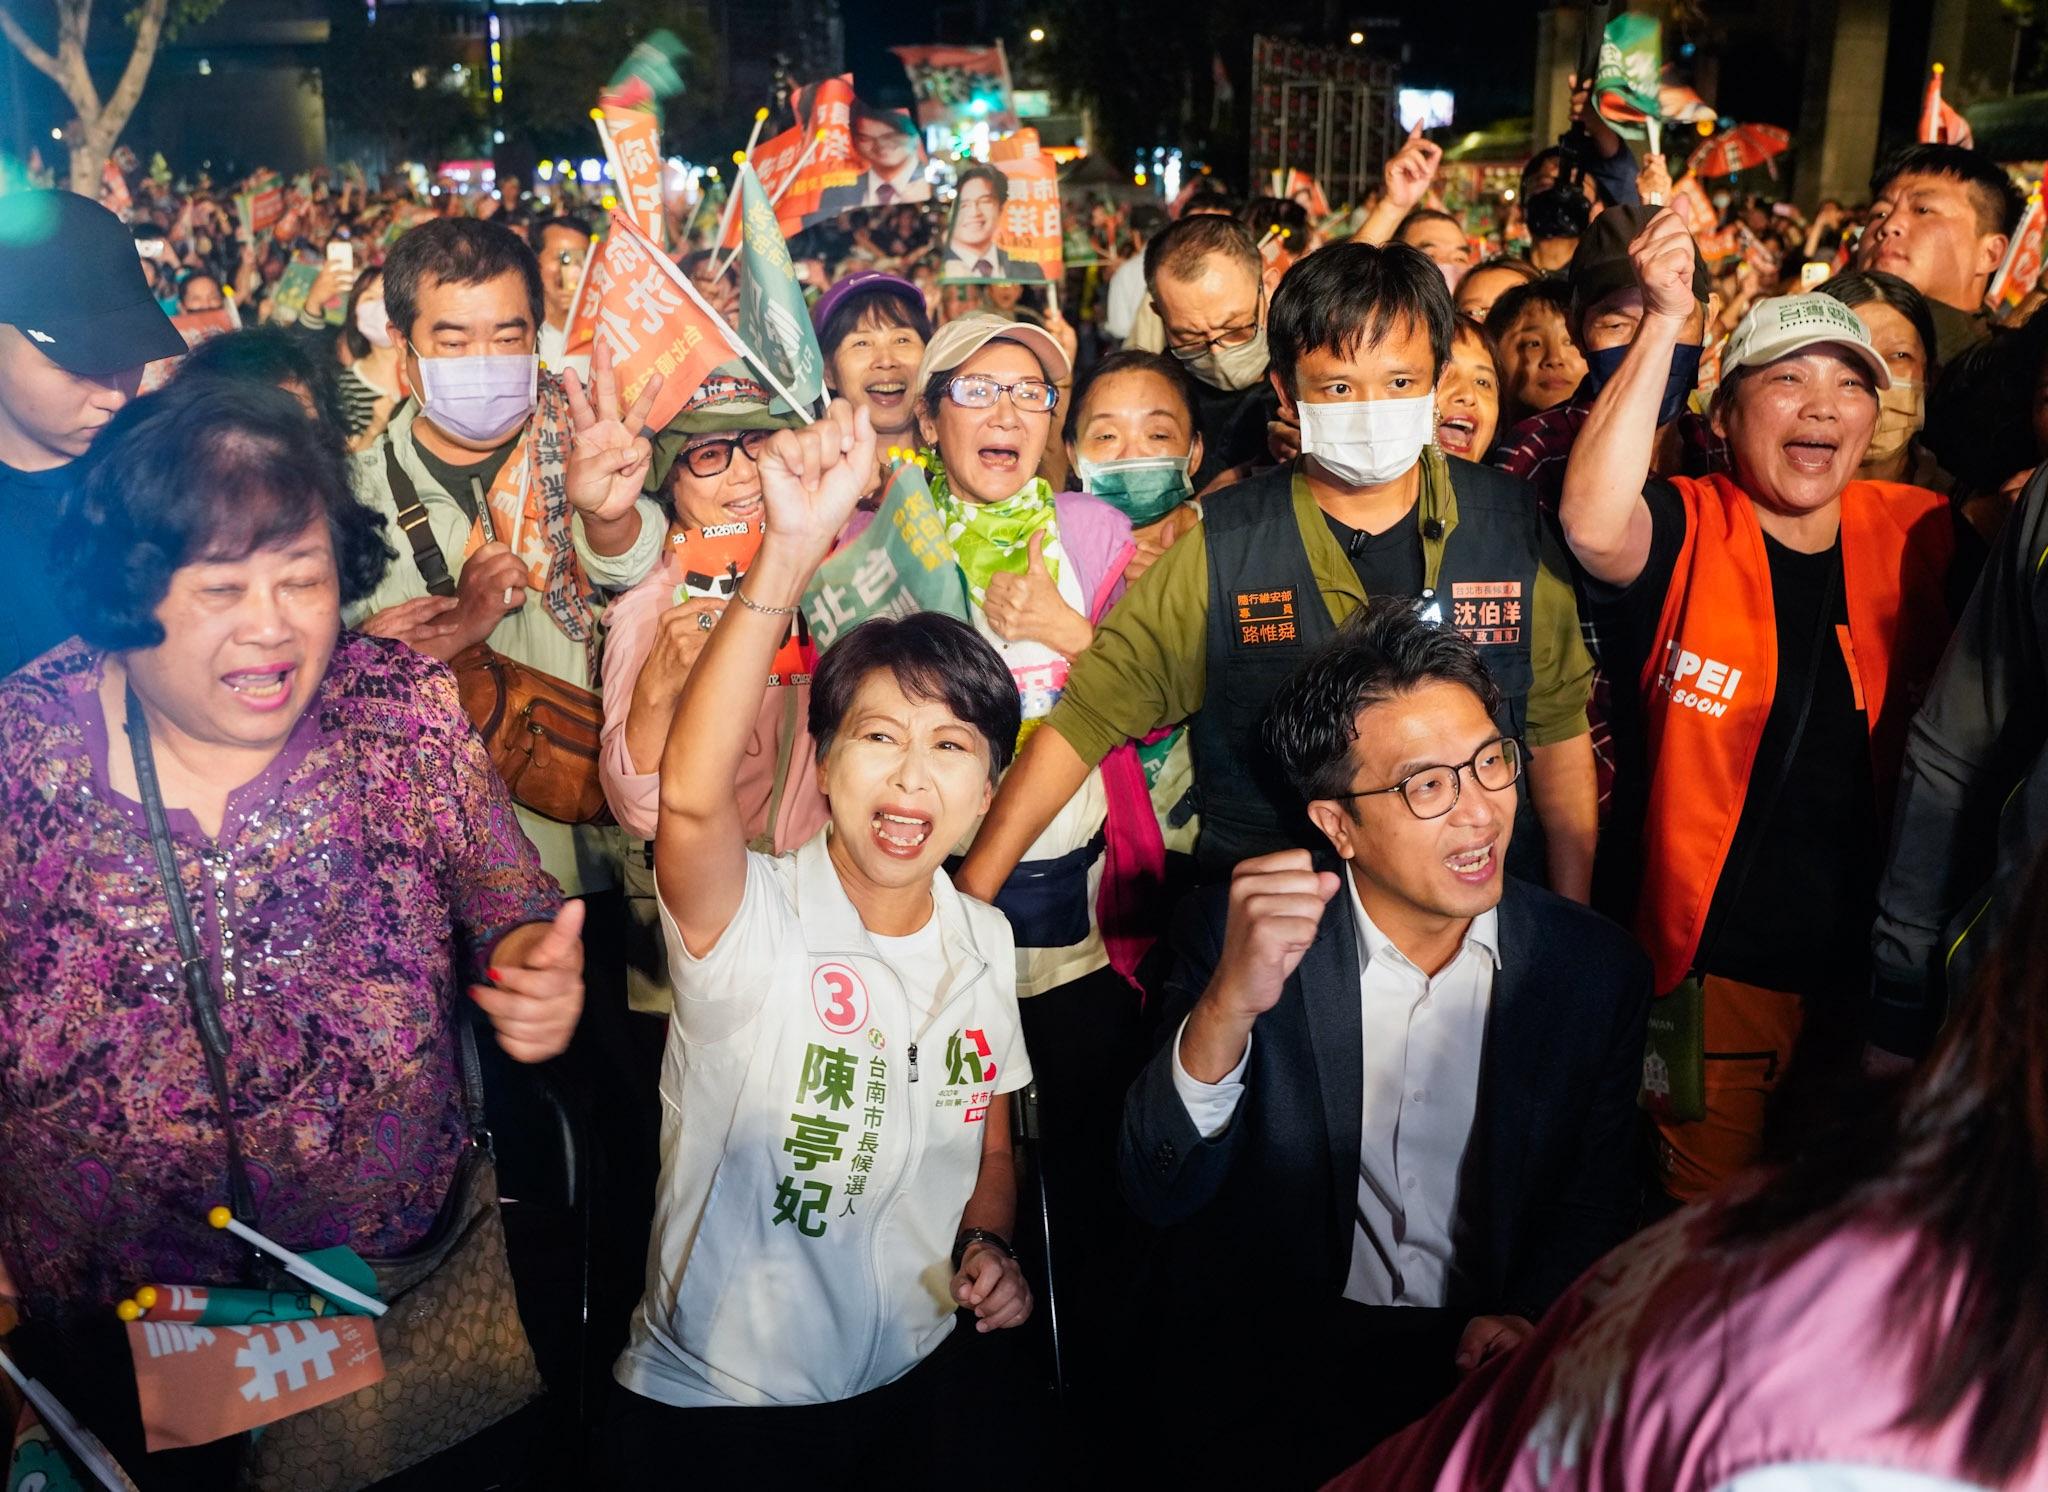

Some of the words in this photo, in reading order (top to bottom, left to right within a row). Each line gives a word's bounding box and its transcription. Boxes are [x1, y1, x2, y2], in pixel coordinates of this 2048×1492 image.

[1242, 622, 1296, 644] 路惟舜
[1453, 601, 1521, 626] 沈伯洋
[1673, 688, 1728, 719] SOON
[819, 969, 860, 1029] 3
[772, 1042, 859, 1238] 陳亭妃
[838, 1055, 888, 1218] 台南市長候選人
